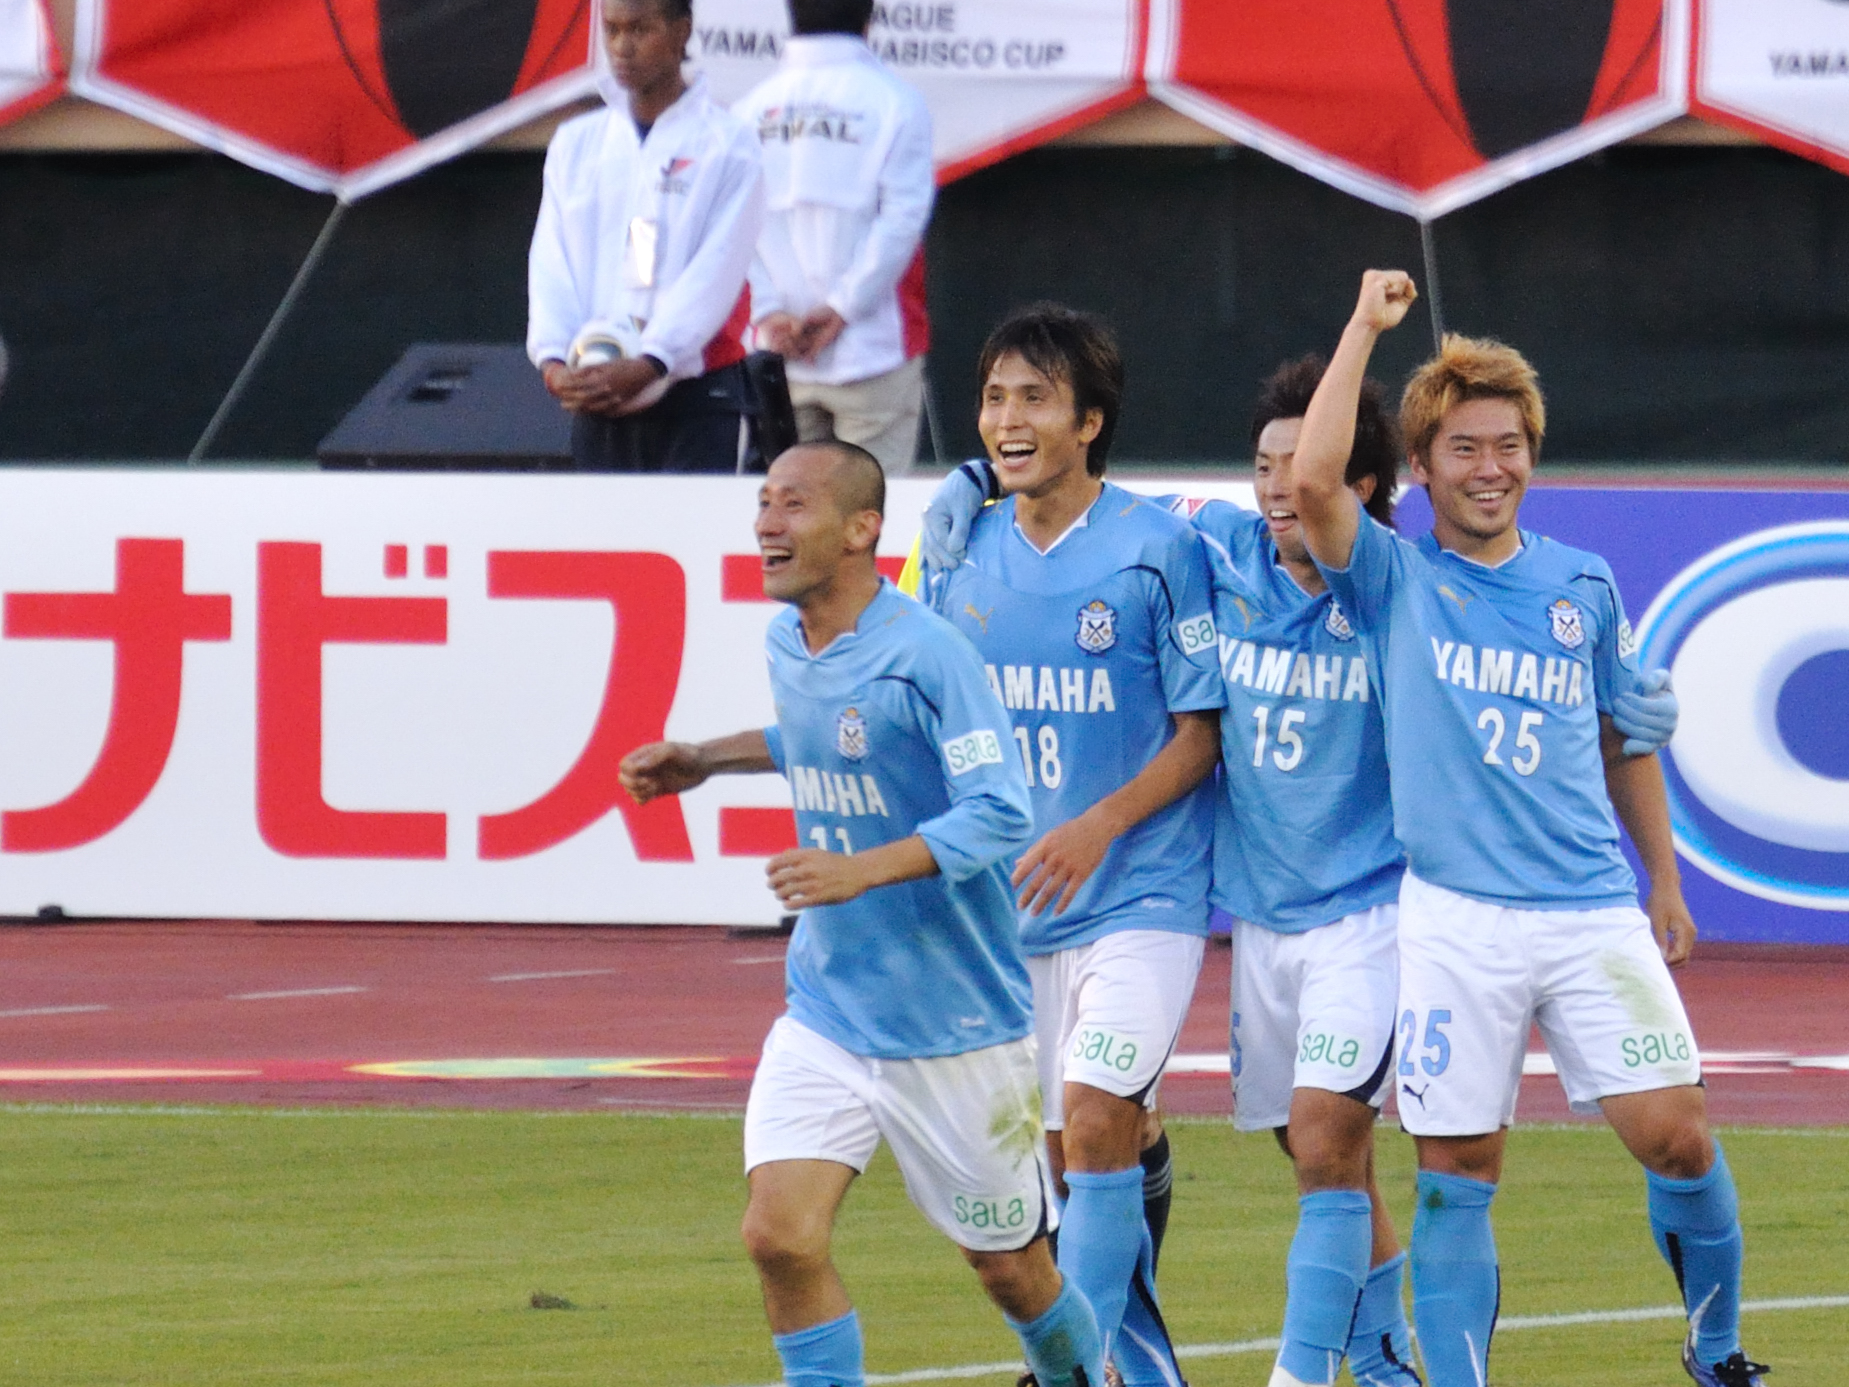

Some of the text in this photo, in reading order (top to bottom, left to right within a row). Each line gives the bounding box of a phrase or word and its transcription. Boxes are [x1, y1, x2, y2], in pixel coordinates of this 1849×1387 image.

[1004, 43, 1065, 66] CUP
[757, 120, 861, 145] FINAL
[1219, 634, 1369, 703] YAMAHA
[1430, 636, 1584, 707] YAMAHA
[948, 728, 999, 770] sala
[1014, 724, 1062, 790] 18
[1252, 705, 1306, 772] 15
[1476, 707, 1544, 777] 25
[788, 765, 889, 817] MAHA
[1073, 1030, 1138, 1072] sala
[1299, 1032, 1360, 1069] sala
[1398, 1009, 1452, 1077] 25
[1621, 1032, 1690, 1068] sala
[954, 1195, 1025, 1229] sala
